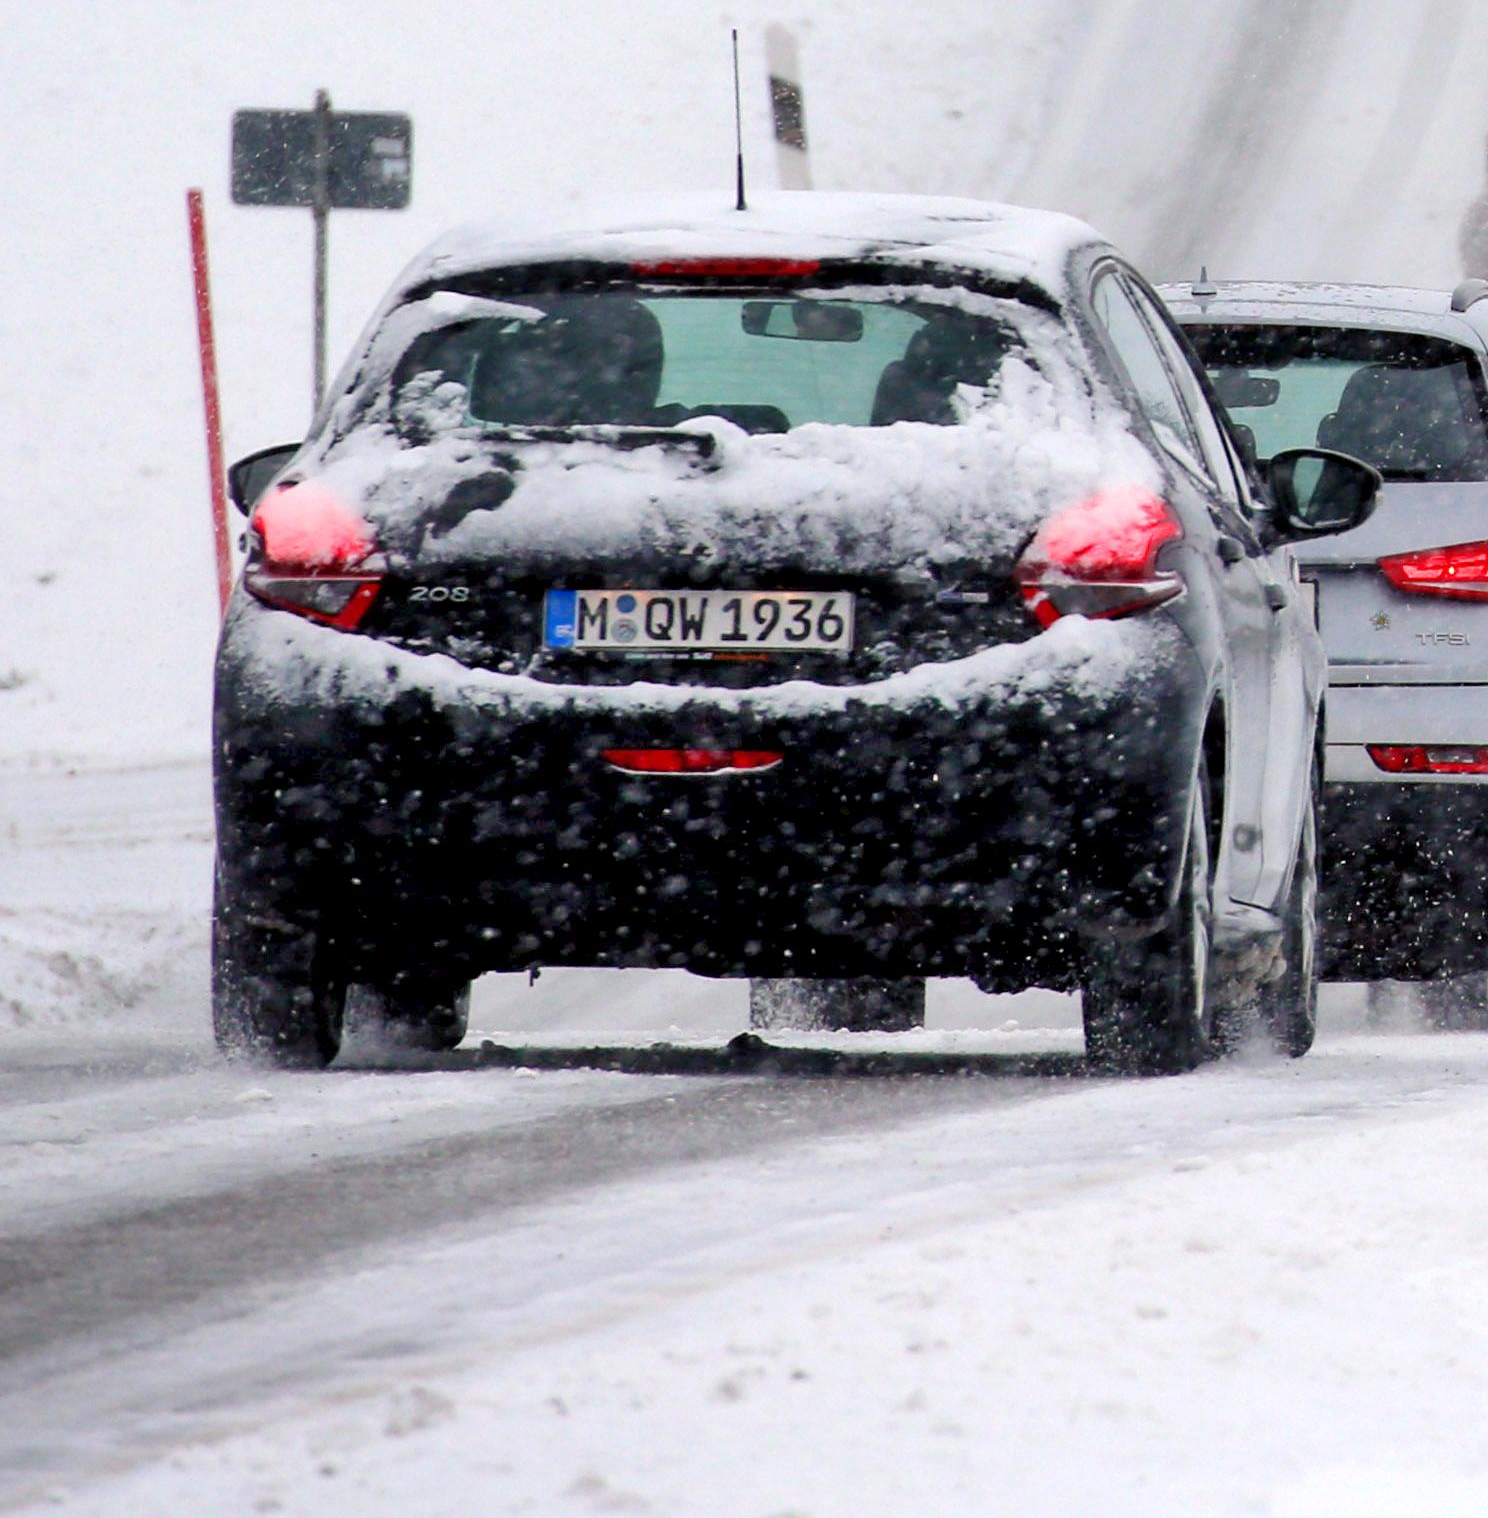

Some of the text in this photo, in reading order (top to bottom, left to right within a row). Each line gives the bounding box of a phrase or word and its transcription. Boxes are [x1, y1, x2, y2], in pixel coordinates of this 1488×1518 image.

[409, 586, 470, 602] 208
[577, 597, 844, 642] M QW 1936
[1415, 633, 1471, 646] TFSI
